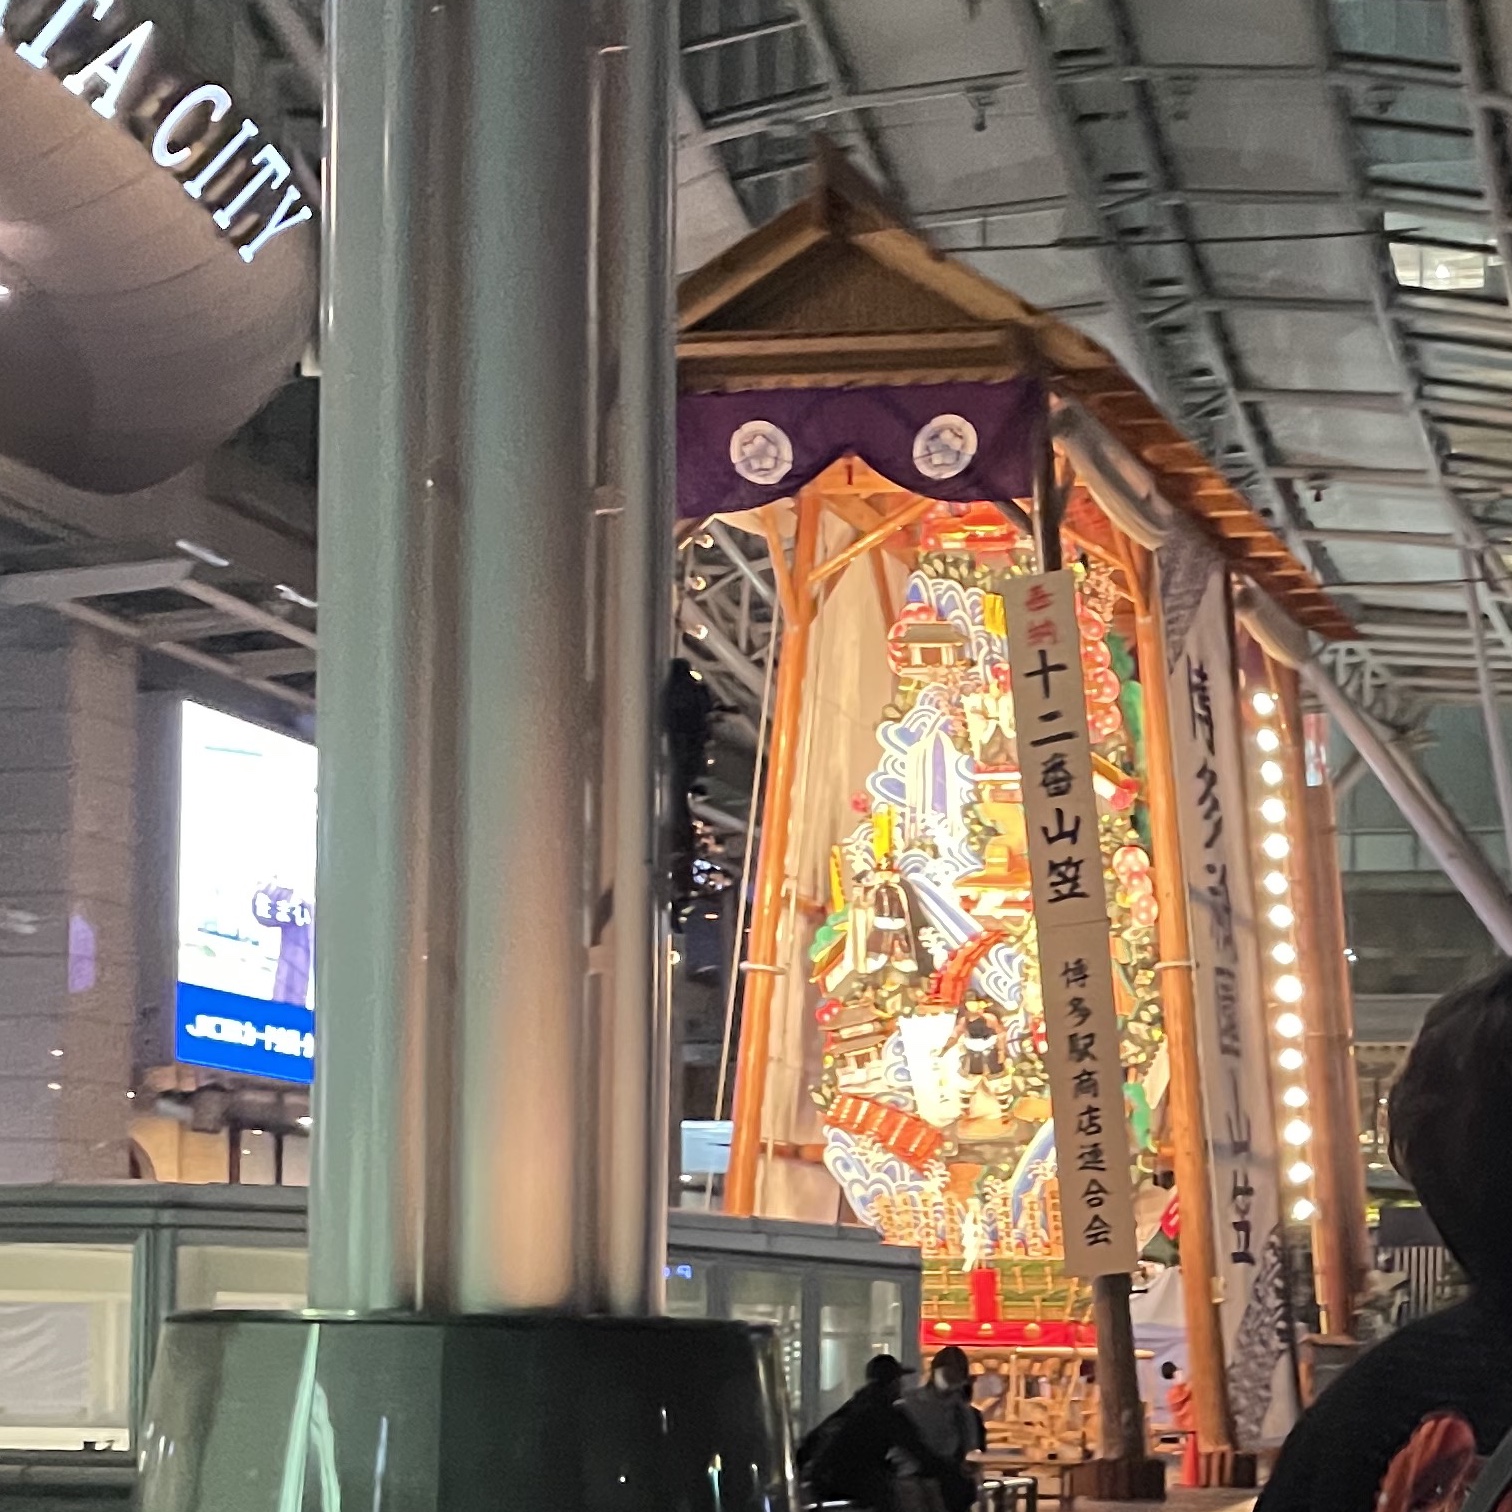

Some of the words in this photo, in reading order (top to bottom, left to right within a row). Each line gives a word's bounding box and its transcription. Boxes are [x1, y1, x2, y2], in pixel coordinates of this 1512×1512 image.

[0, 0, 153, 119] TA
[152, 84, 312, 263] CITY
[1023, 649, 1090, 904] 十二番山笠
[1060, 957, 1112, 1246] 博多駅商店連合会
